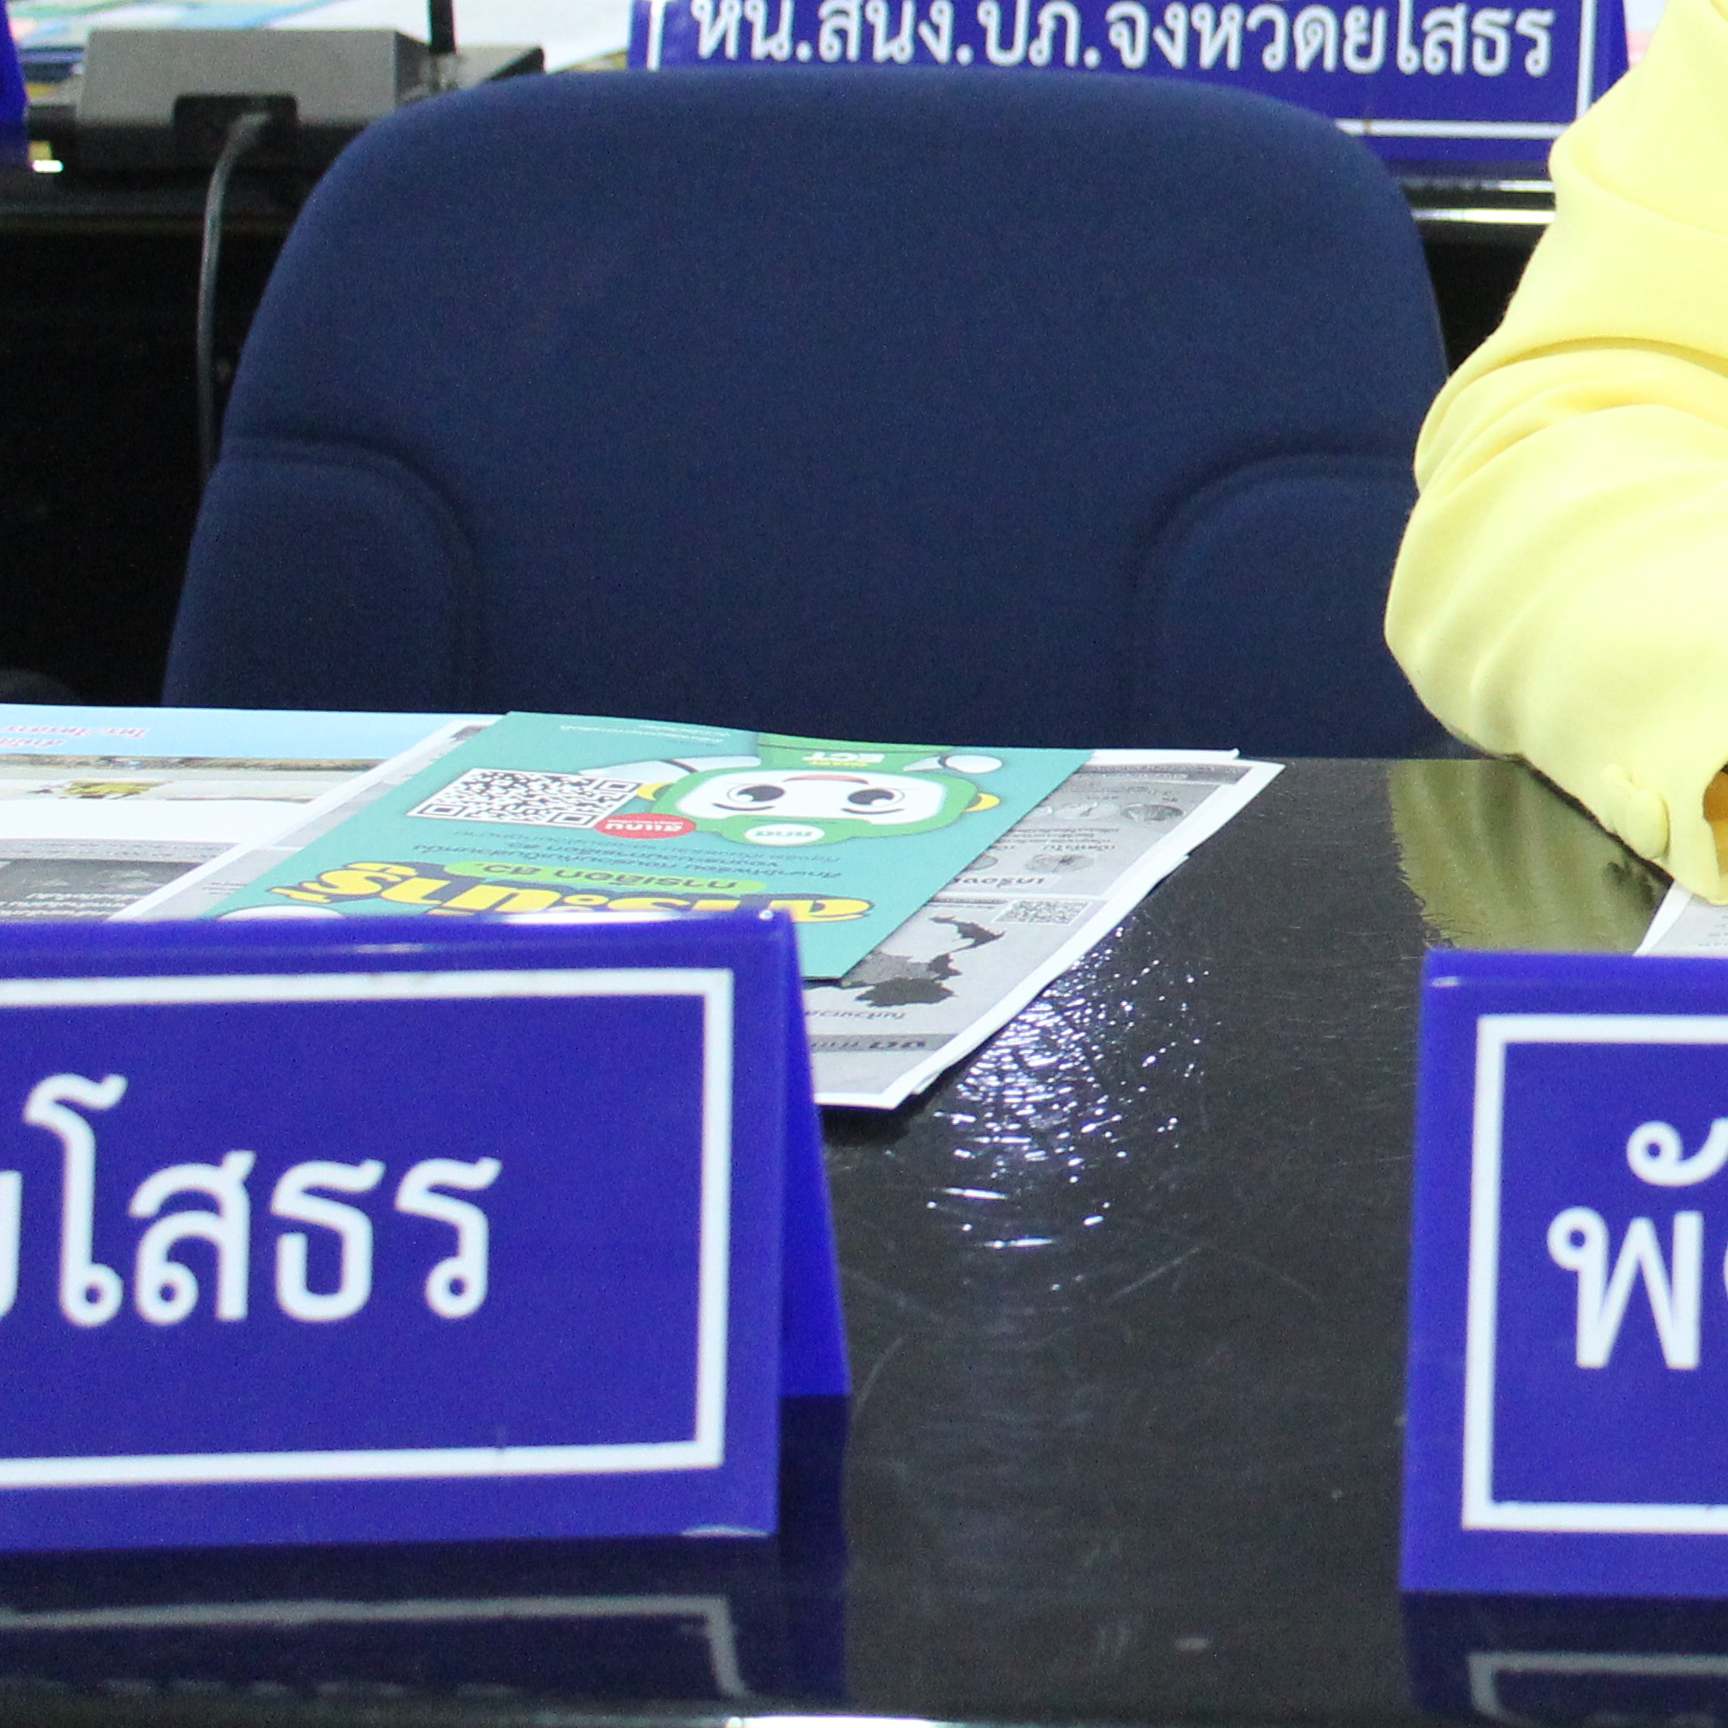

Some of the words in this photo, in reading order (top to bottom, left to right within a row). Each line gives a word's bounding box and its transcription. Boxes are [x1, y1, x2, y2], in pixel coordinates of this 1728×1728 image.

[801, 752, 885, 763] ECT
[554, 869, 738, 890] การเลือก
